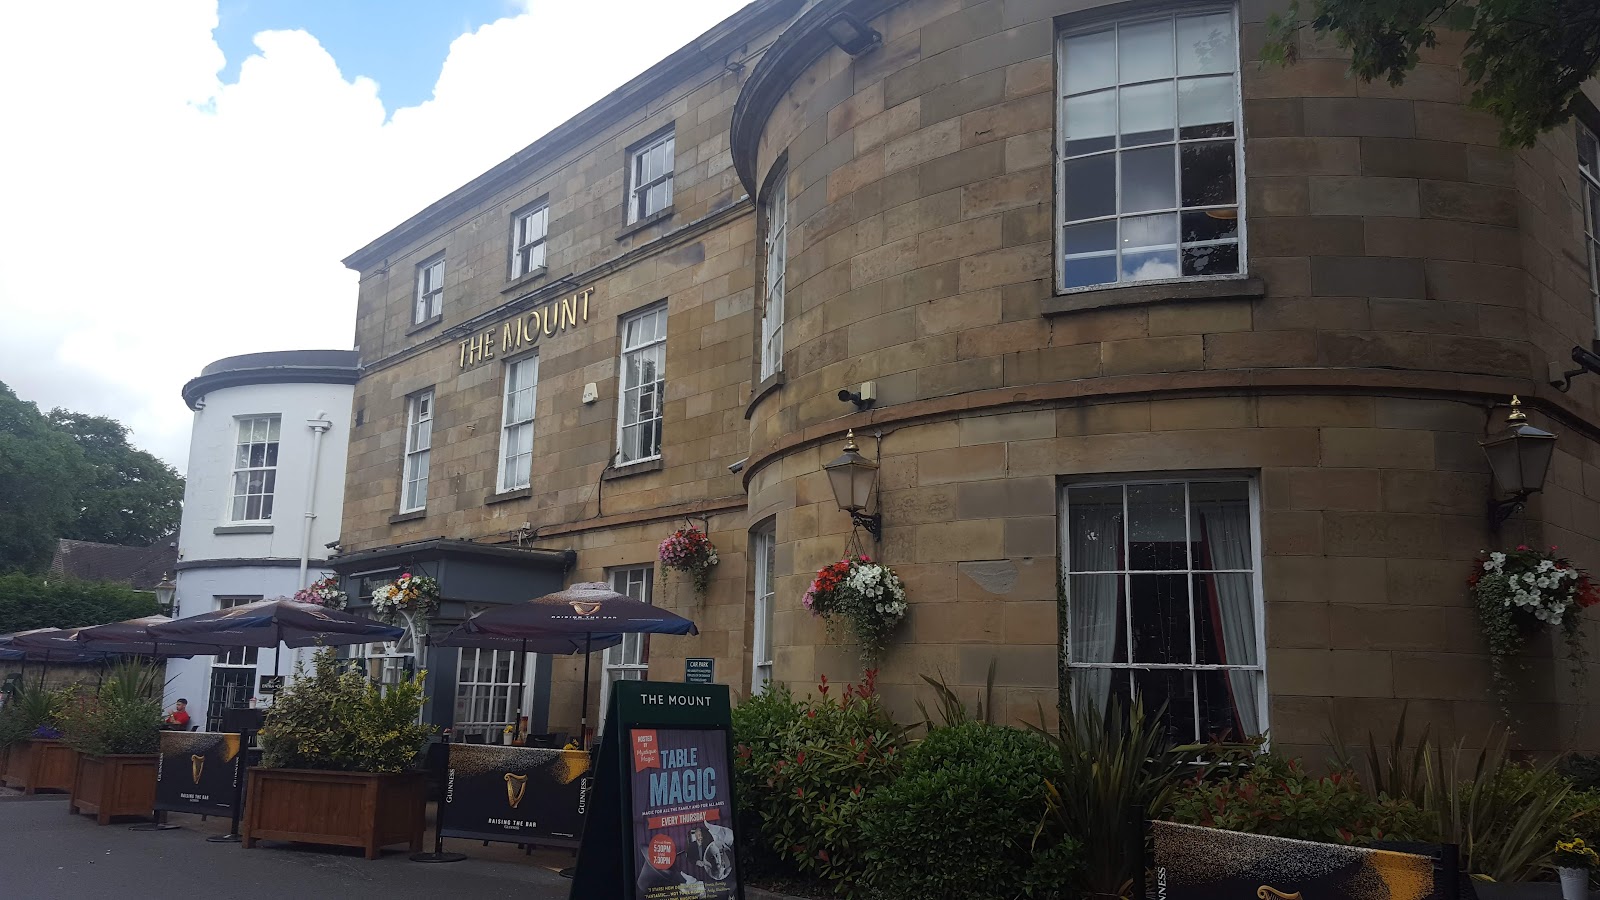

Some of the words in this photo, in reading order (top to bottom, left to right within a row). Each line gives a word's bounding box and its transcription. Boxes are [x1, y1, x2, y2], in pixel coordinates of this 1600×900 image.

[458, 328, 496, 368] THE
[503, 287, 594, 352] MOUNT
[640, 694, 664, 705] THE
[668, 695, 712, 707] MOUNT
[661, 747, 697, 769] TABLE
[446, 769, 455, 803] GUINNESS
[578, 778, 587, 814] GUINNESS
[650, 767, 715, 806] MAGIC
[661, 815, 679, 827] EVERY
[679, 811, 707, 824] THURSDAY
[653, 855, 671, 865] 7:30PM
